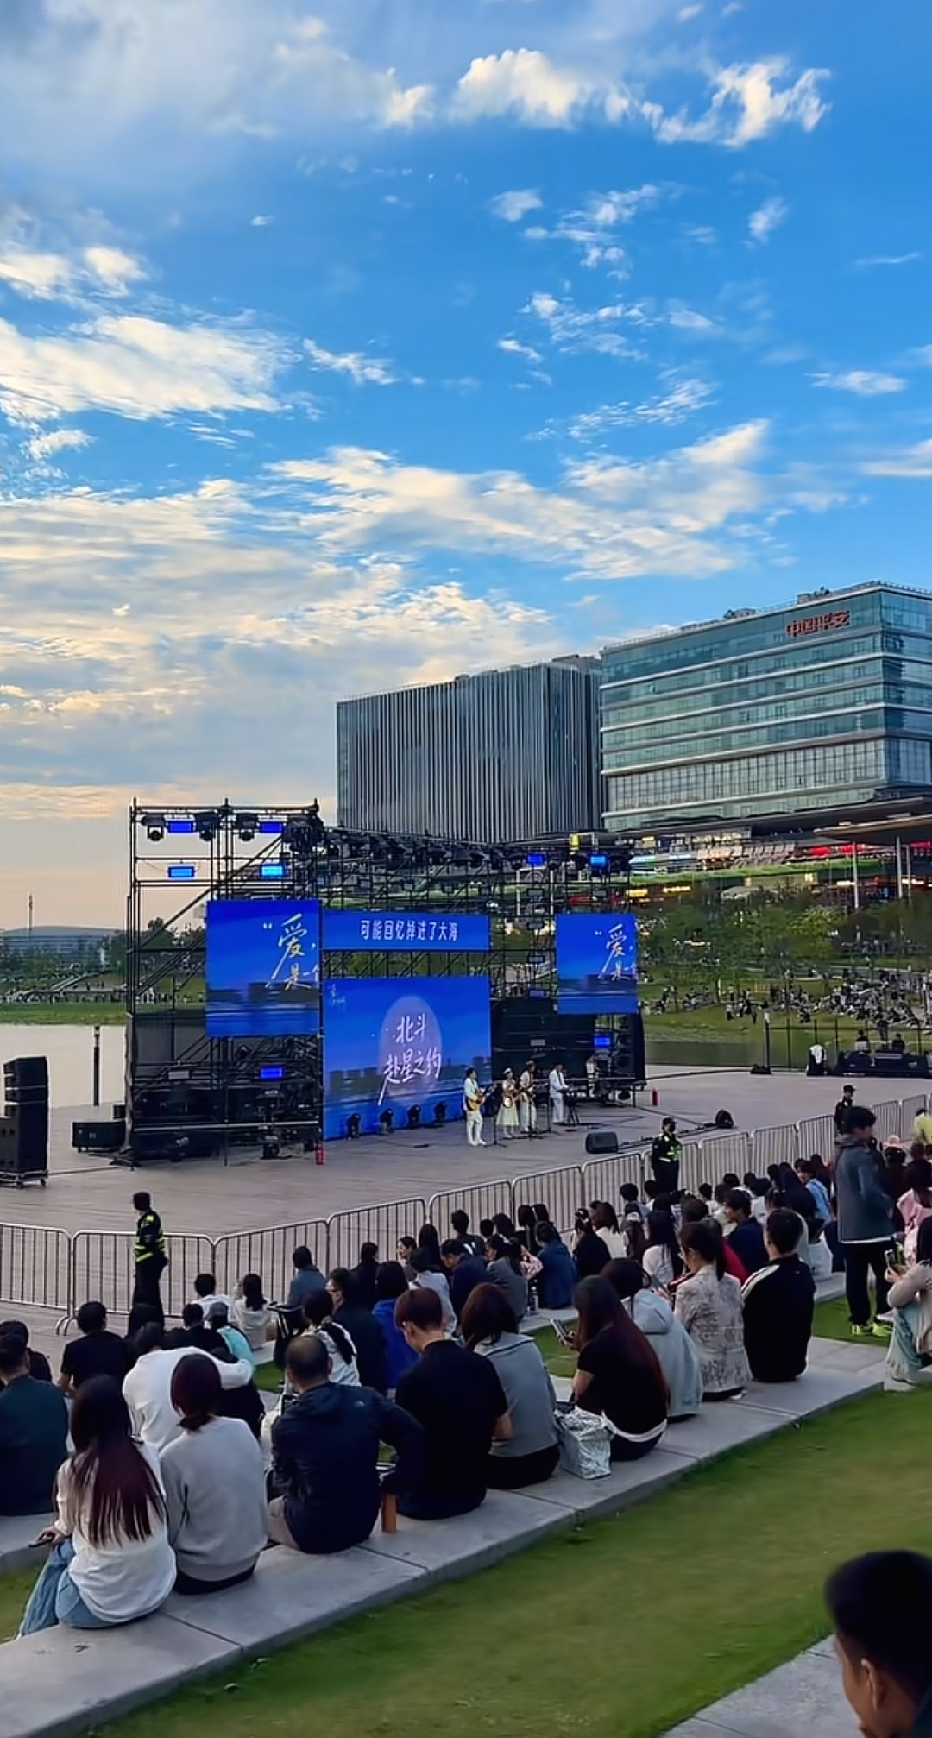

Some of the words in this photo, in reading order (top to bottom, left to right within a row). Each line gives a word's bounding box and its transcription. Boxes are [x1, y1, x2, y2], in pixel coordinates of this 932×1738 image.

[786, 610, 850, 637] 中国平安
[360, 920, 459, 941] 可能回忆掉进了大海
[395, 1013, 426, 1043] 北斗
[378, 1046, 442, 1106] 赴星之约
